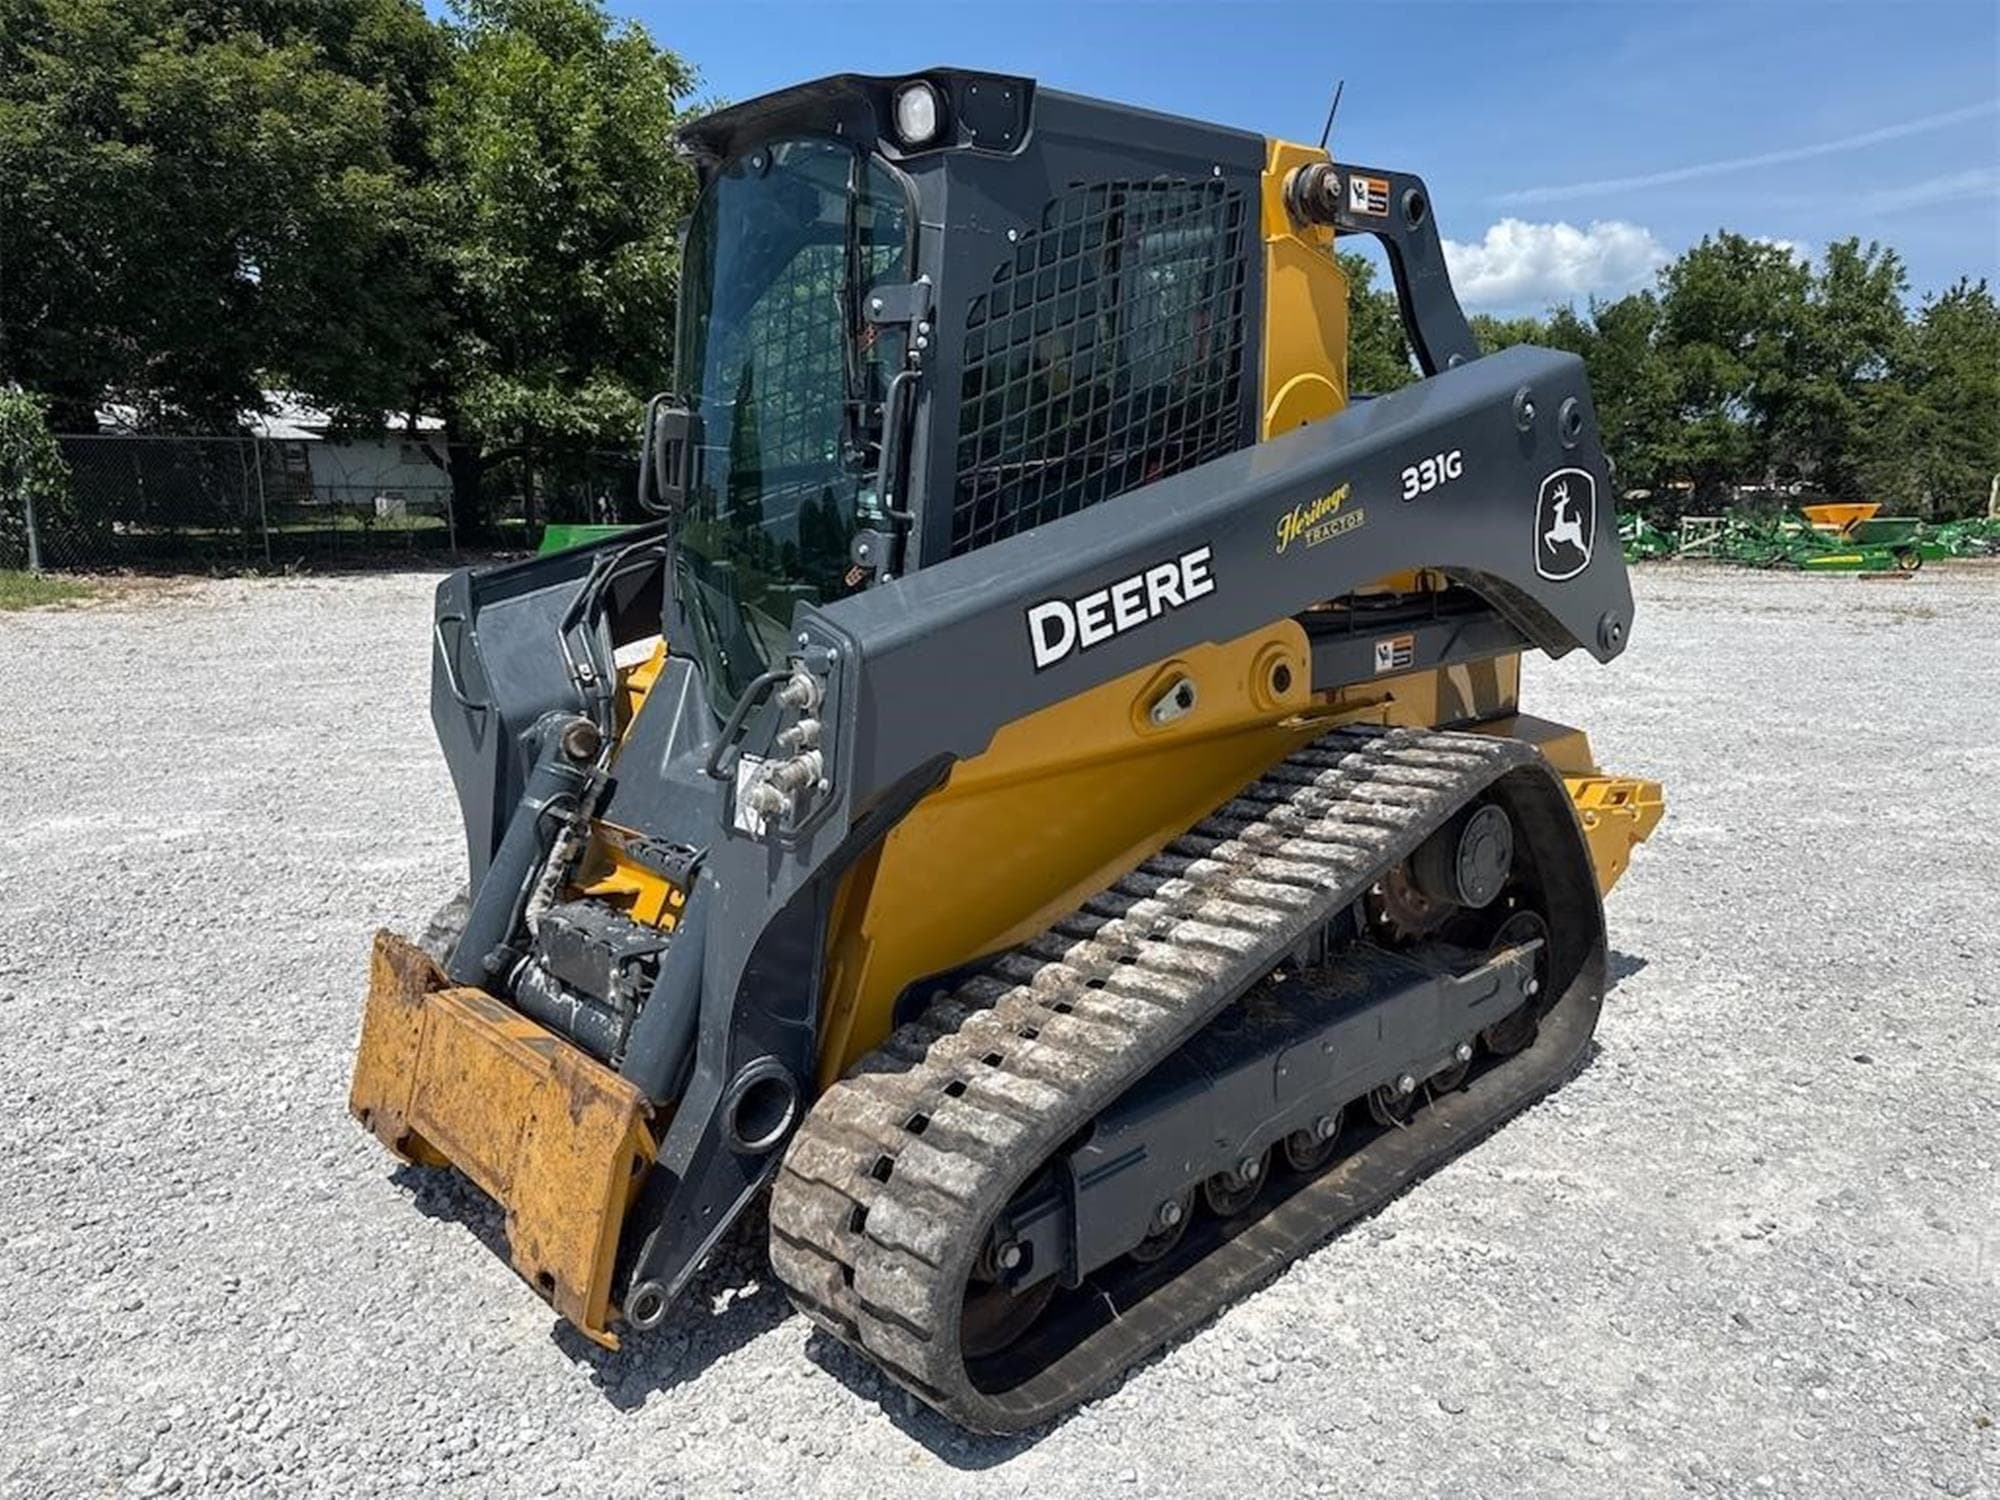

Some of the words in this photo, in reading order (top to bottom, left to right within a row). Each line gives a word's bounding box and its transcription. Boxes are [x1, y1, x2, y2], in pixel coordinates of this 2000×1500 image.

[1401, 451, 1463, 500] 331G
[1276, 483, 1352, 554] Heritage
[1305, 510, 1365, 544] TRACTOR
[1028, 547, 1215, 668] DEERE
